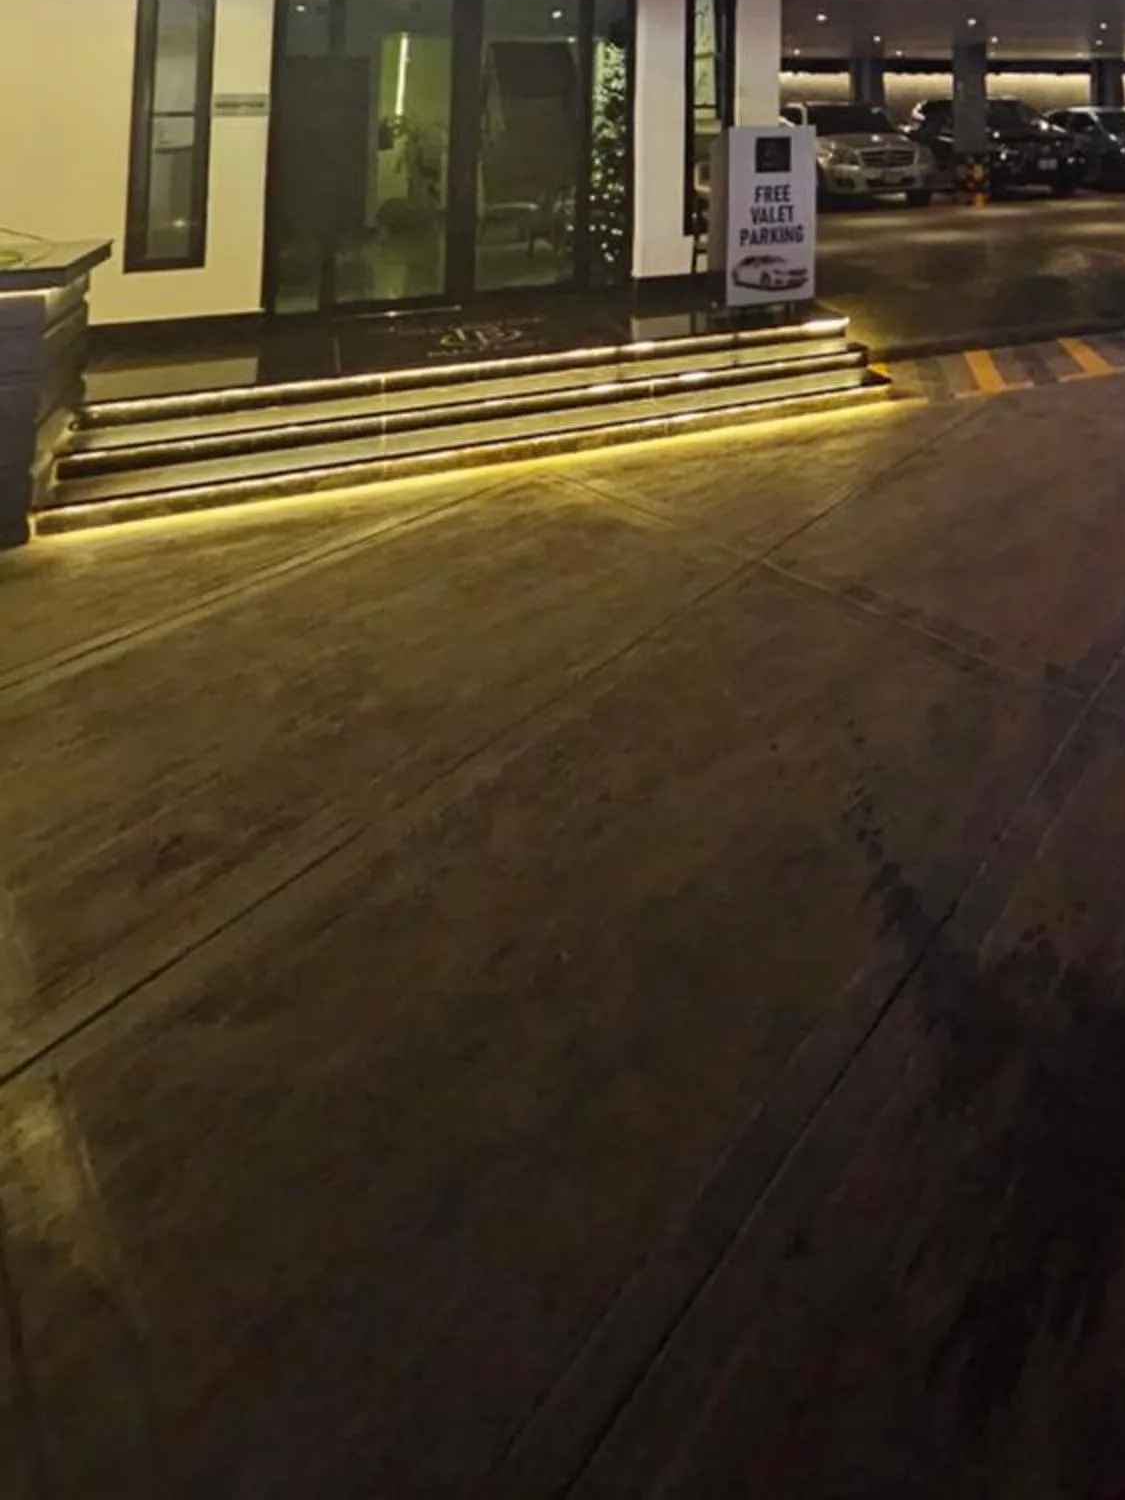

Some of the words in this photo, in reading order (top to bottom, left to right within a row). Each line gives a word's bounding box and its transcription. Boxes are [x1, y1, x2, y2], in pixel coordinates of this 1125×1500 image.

[754, 184, 791, 203] FREE
[750, 205, 795, 225] VALET
[739, 226, 805, 247] PARKING
